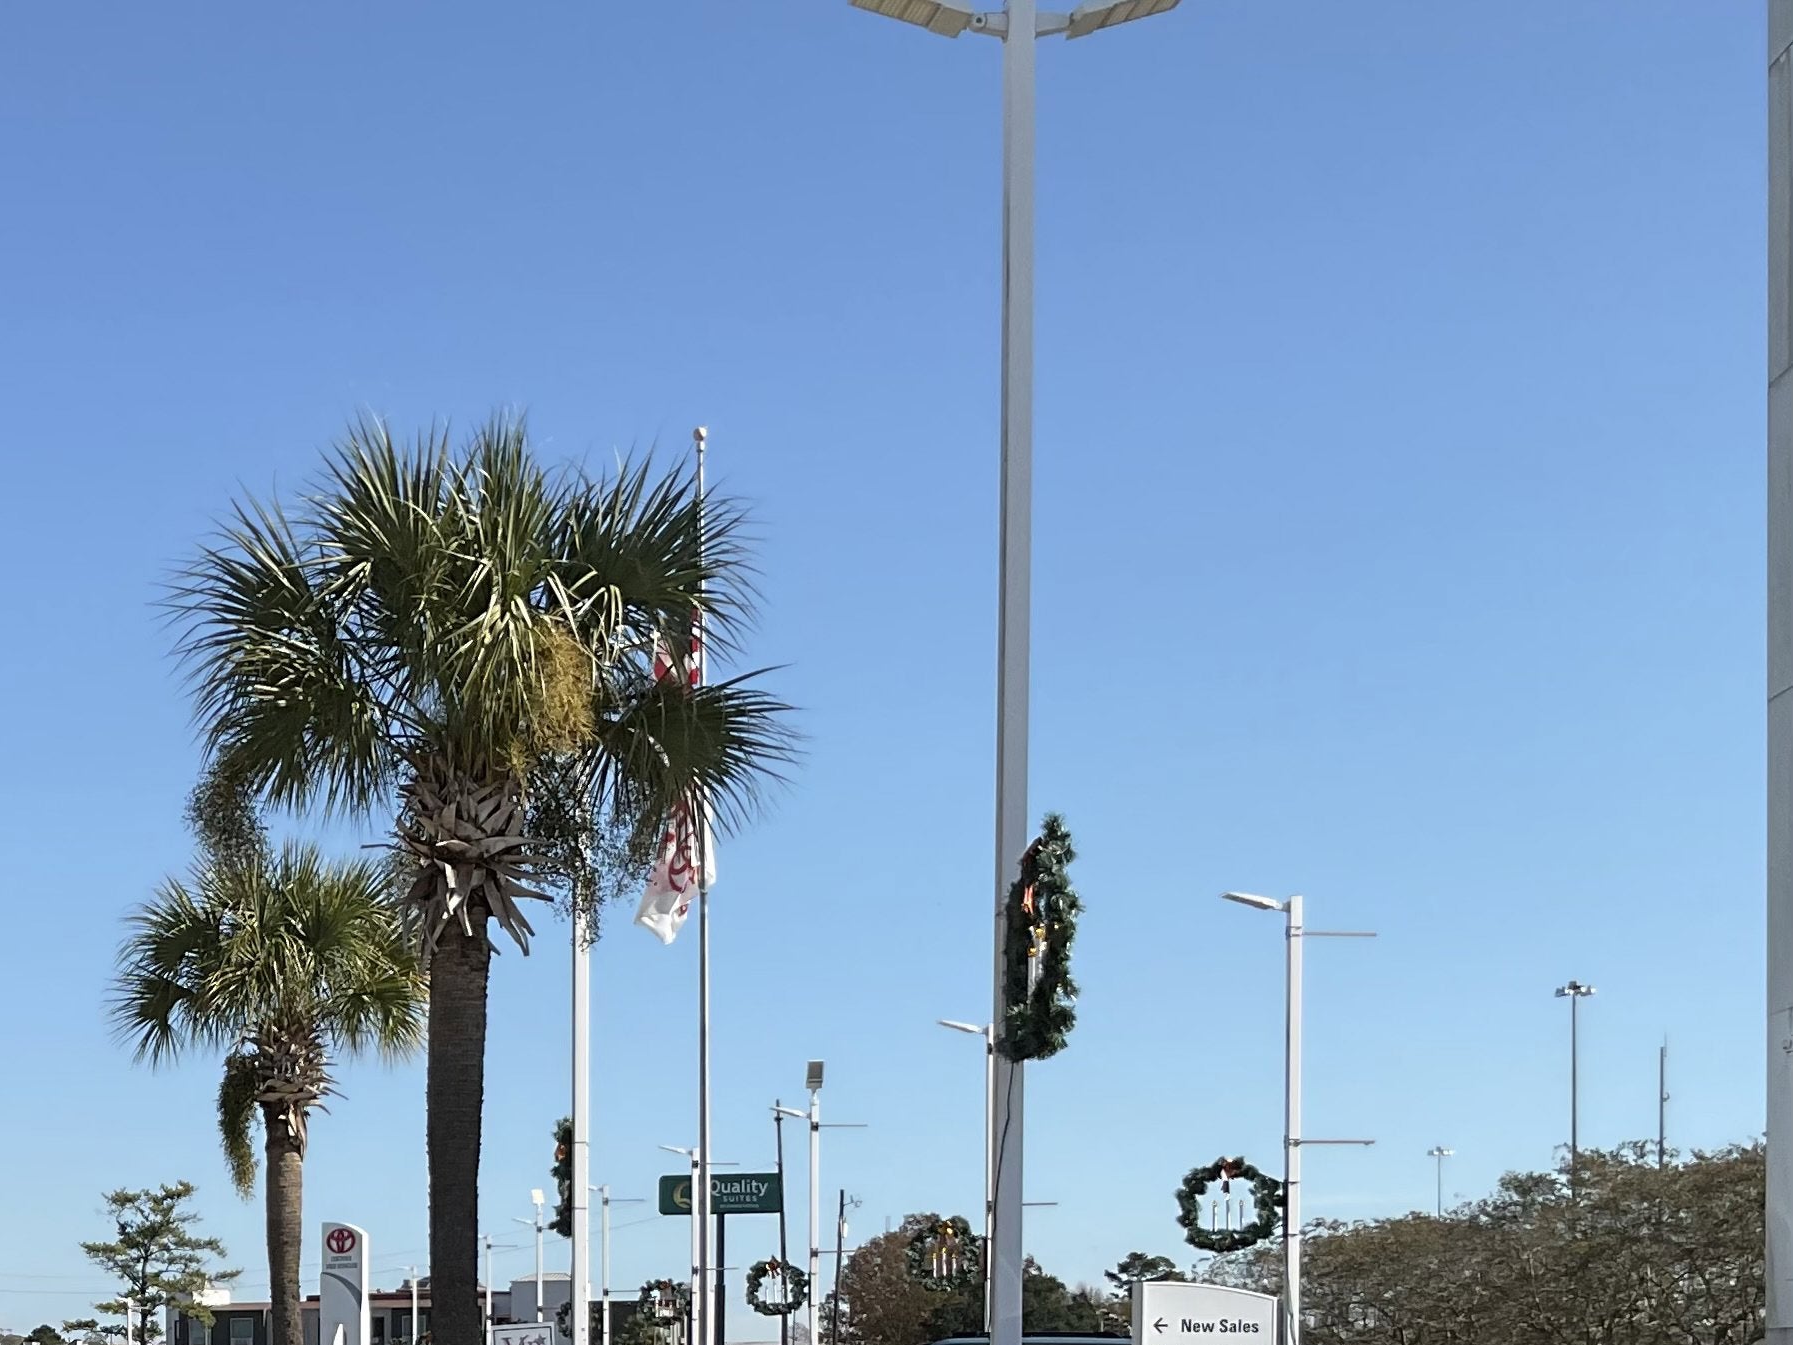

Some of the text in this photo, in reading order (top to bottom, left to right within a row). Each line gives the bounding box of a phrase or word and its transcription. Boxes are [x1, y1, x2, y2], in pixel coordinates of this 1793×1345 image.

[710, 1179, 768, 1197] Quality
[1181, 1319, 1259, 1333] New Sales
